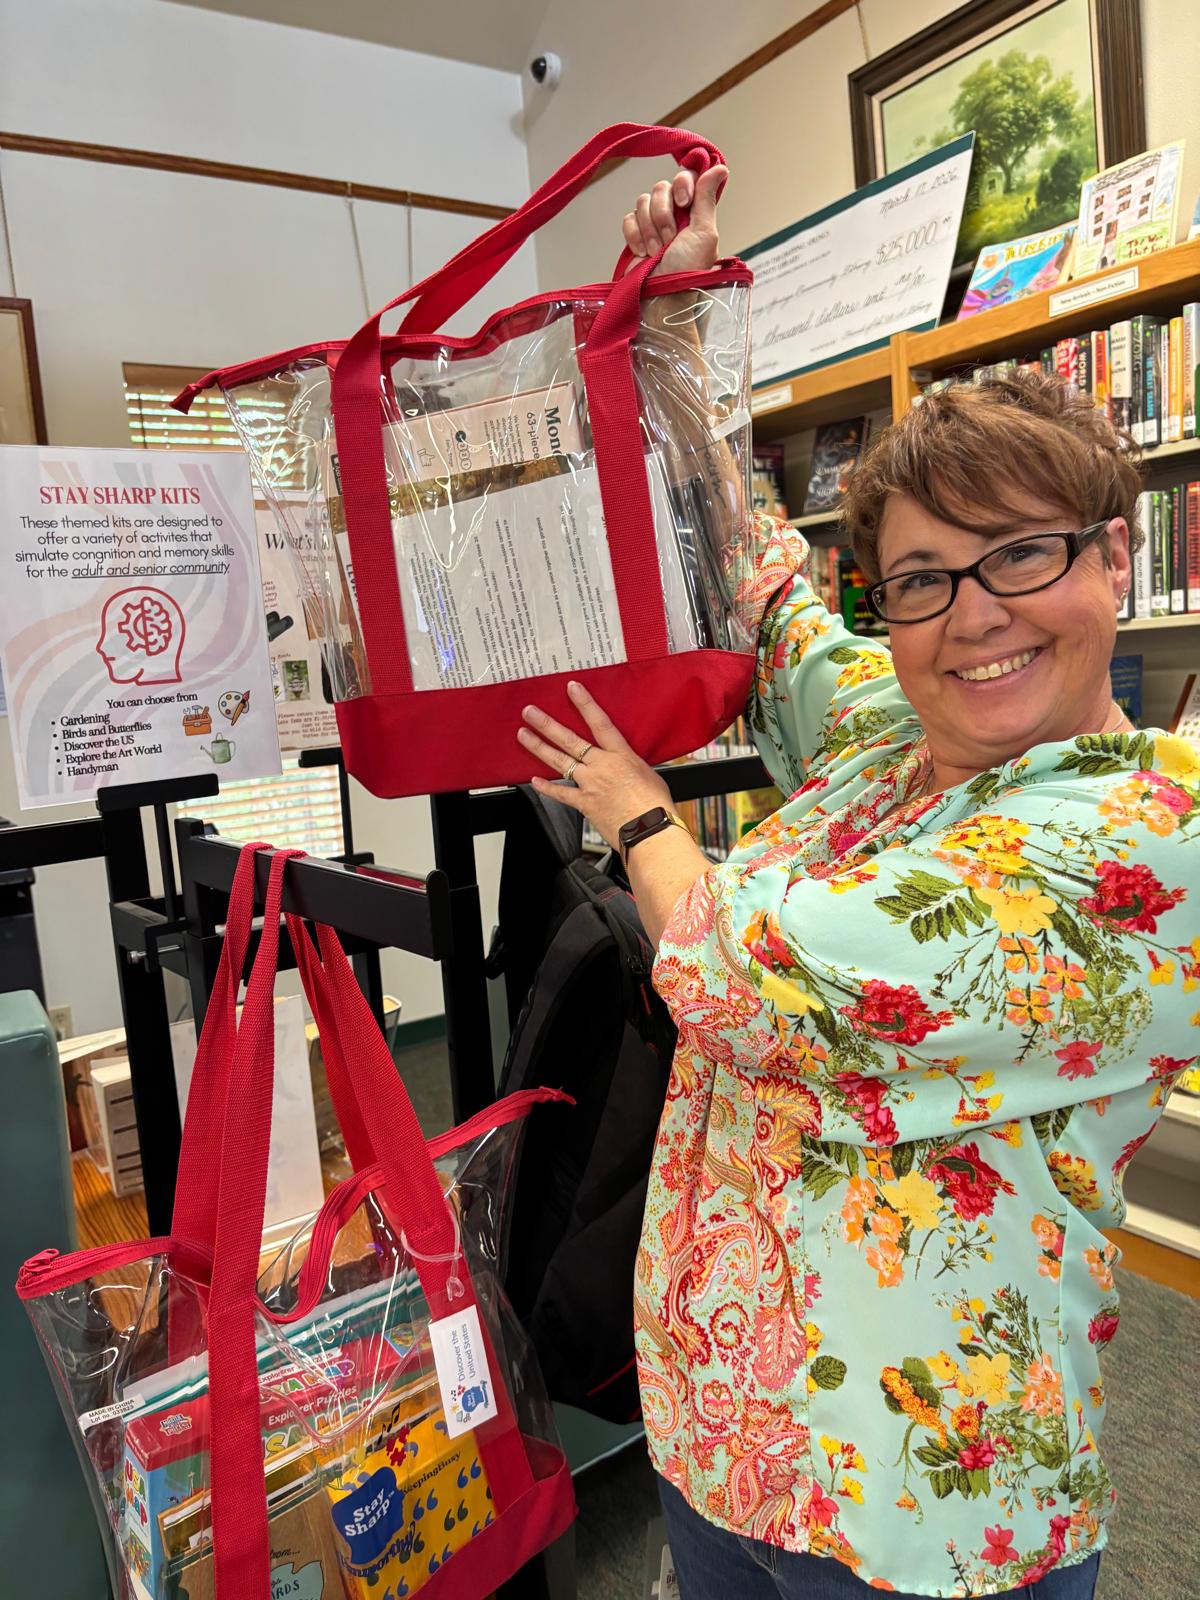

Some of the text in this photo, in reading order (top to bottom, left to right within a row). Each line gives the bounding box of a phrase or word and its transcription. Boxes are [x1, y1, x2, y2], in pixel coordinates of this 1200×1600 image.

[39, 486, 201, 505] STAY SHARP KITS
[20, 516, 223, 530] These themed kits are designed to
[37, 530, 212, 547] offer a variety of activites that
[15, 545, 235, 564] simulate congnition and memory skills
[26, 562, 230, 578] for the adult and senior community.
[107, 693, 198, 709] You can choose from
[61, 714, 110, 727] Gardening
[62, 722, 152, 739] Birds and Butterflies
[64, 735, 134, 752] Discover the US
[66, 744, 162, 765] Explore the Art World
[67, 762, 119, 777] Handyman
[461, 1323, 476, 1378] United States
[455, 1346, 466, 1382] Discover
[88, 1408, 106, 1418] MADE
[113, 1398, 135, 1409] CHINA
[352, 1488, 386, 1523] Stay
